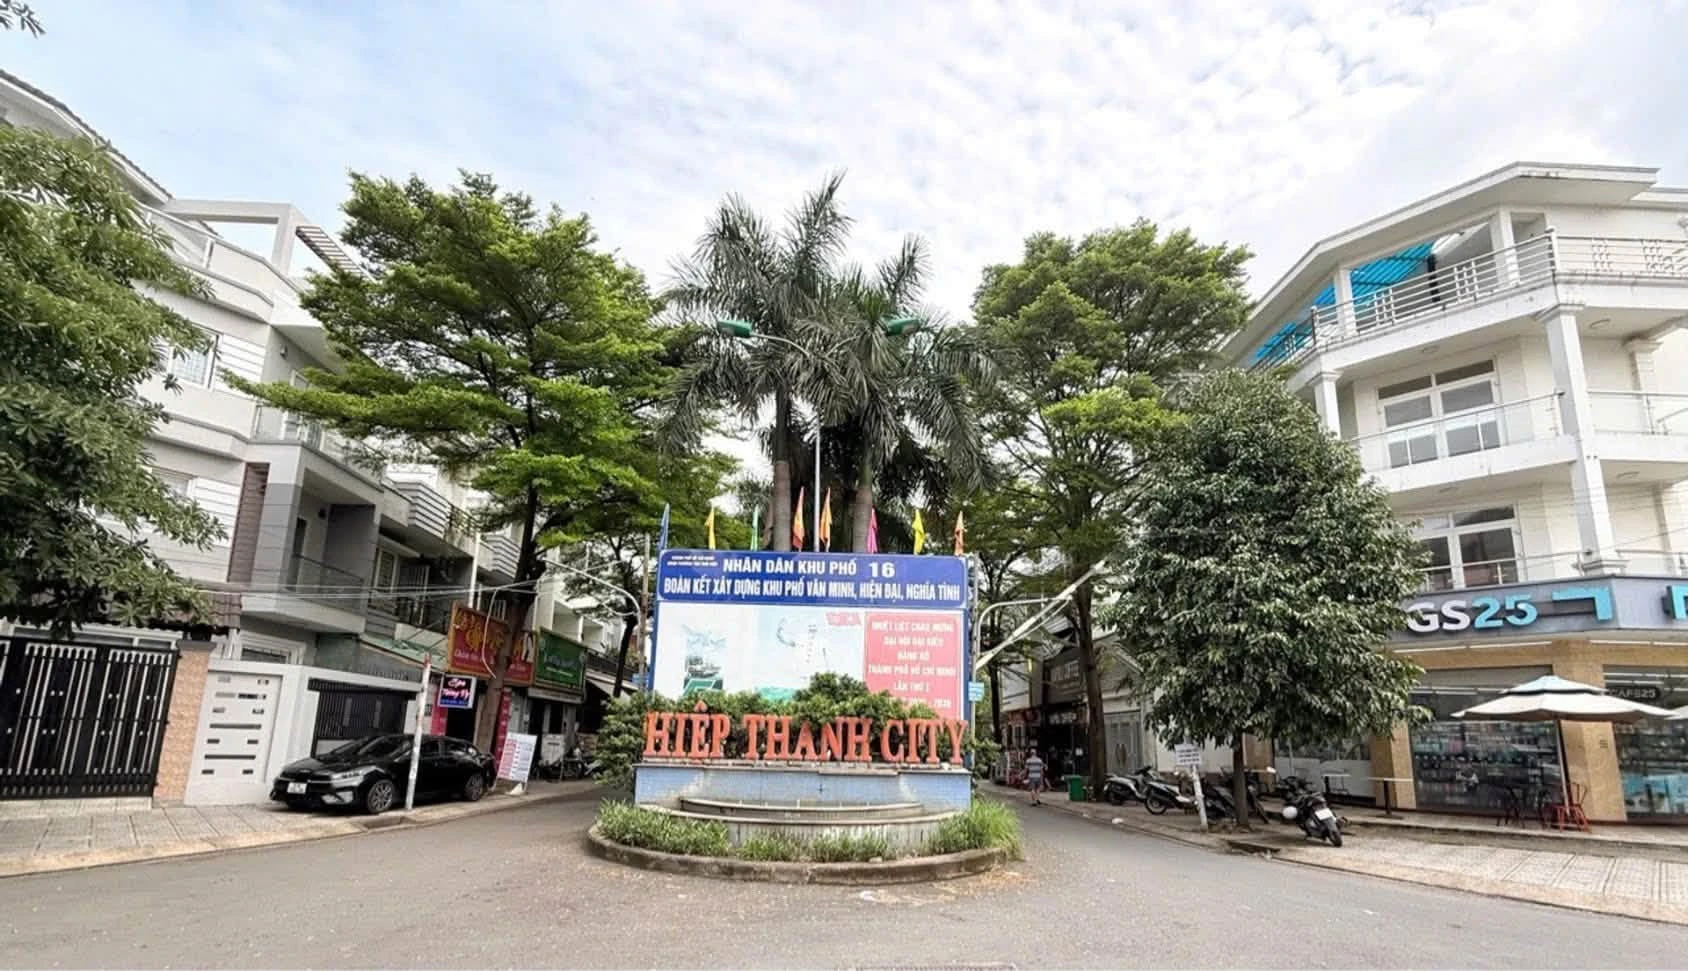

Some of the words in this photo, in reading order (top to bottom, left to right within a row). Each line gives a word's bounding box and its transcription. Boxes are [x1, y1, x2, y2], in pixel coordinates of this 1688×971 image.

[723, 557, 761, 573] NHÂN
[766, 557, 793, 574] DÂN
[798, 560, 825, 574] KHU
[829, 557, 857, 576] PHỐ
[868, 562, 896, 578] 16
[663, 574, 691, 594] ĐOÀN
[692, 574, 711, 595] KẾT
[712, 576, 733, 595] XÂY
[734, 578, 760, 599] DỰNG
[763, 579, 782, 596] KHU
[785, 576, 805, 597] PHỐ
[828, 581, 857, 599] MINH,
[859, 579, 883, 601] HIỆN
[906, 580, 936, 600] NGHĨA
[937, 581, 960, 601] TÌNH
[1406, 595, 1538, 632] GS25
[643, 700, 730, 764] HIỆP
[880, 717, 969, 764] CITY
